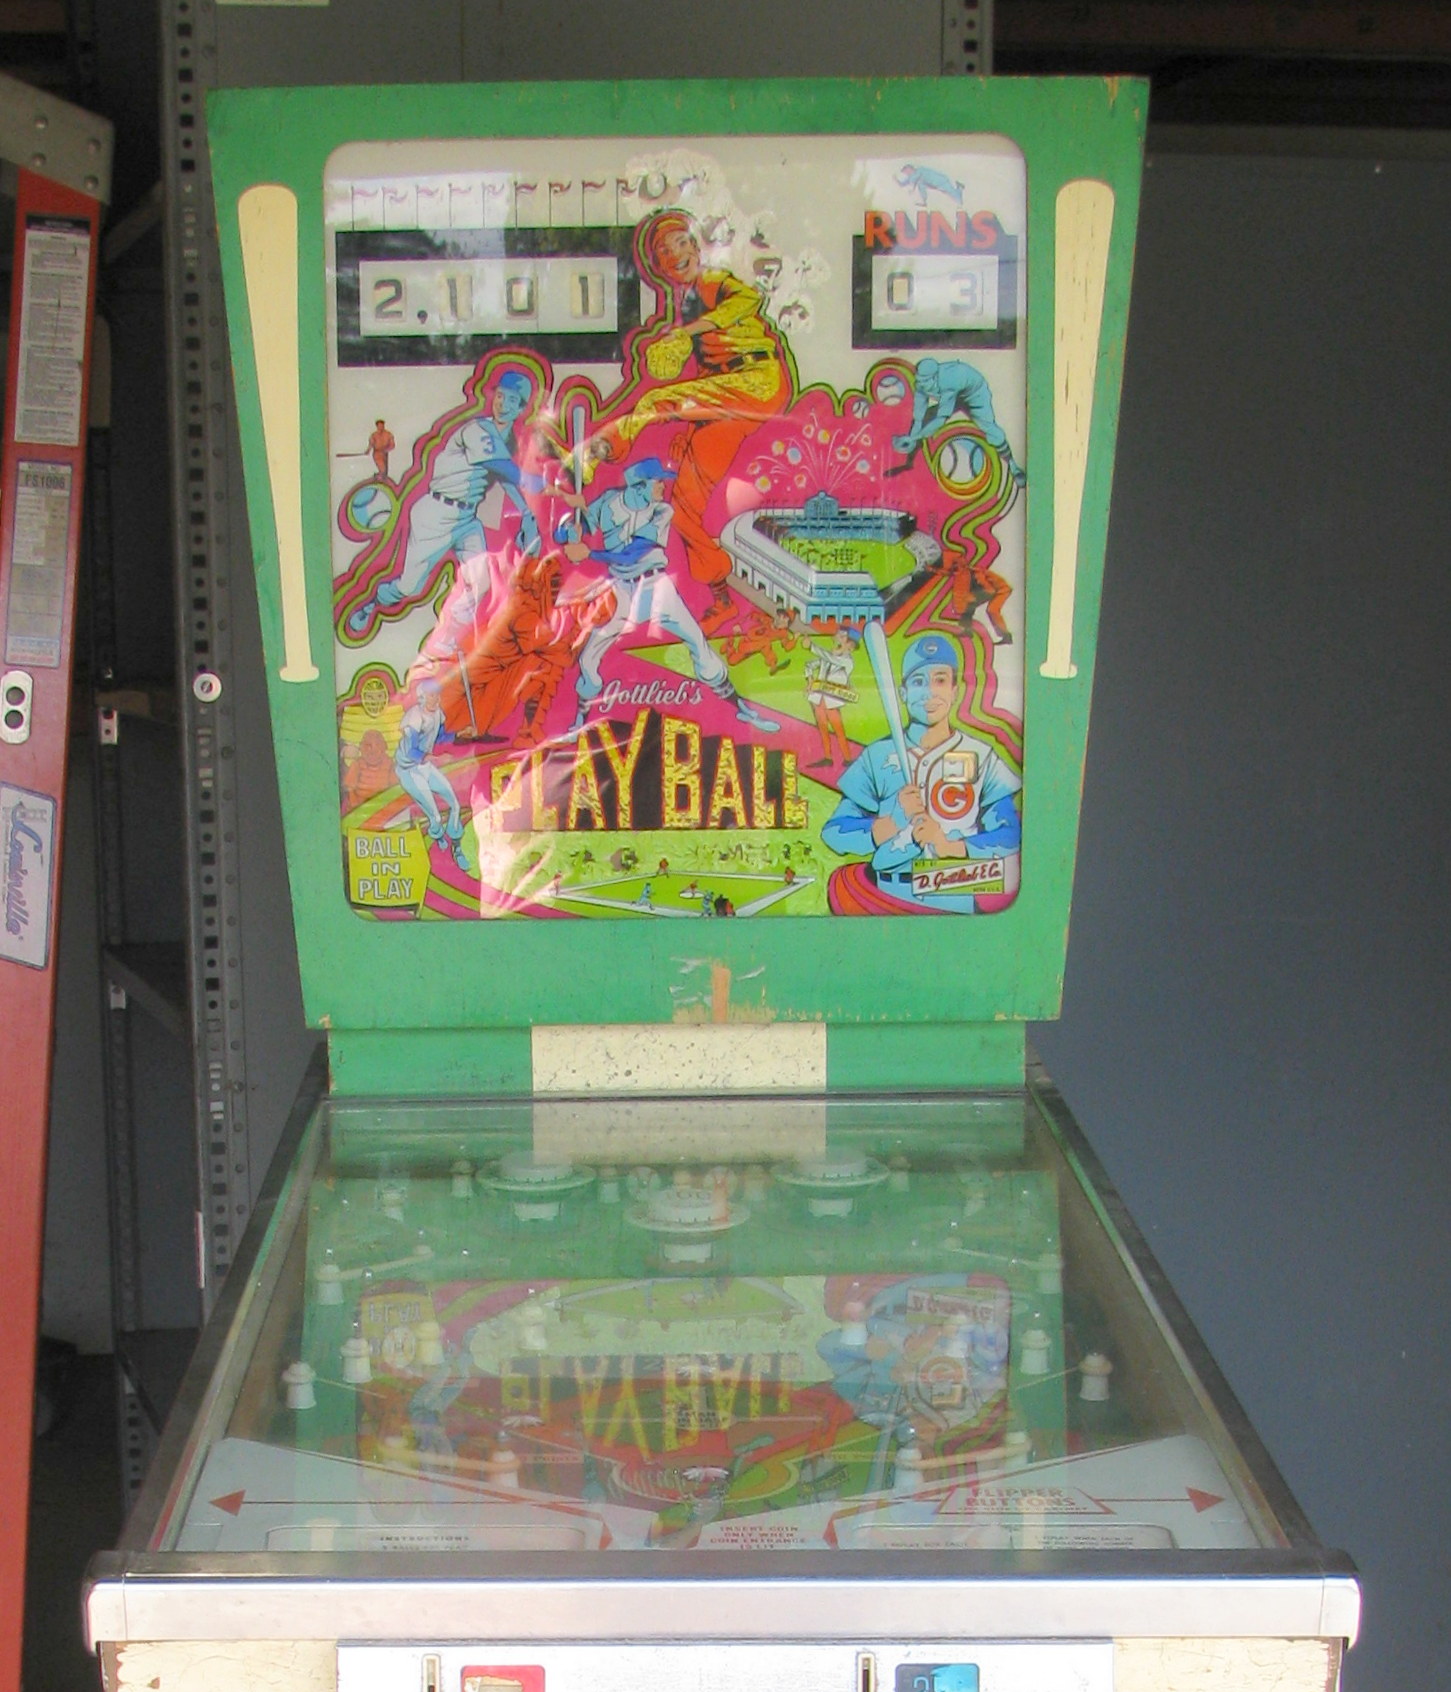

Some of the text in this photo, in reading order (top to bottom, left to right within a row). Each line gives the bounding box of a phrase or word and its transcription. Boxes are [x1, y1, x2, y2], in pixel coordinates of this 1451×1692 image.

[864, 210, 999, 249] RUNS
[598, 679, 704, 713] Gottlieb's
[490, 707, 809, 830] PLAY BALL
[937, 783, 968, 816] G
[355, 836, 411, 858] BALL
[371, 863, 402, 876] IN
[358, 878, 414, 900] PLAY
[965, 1496, 1077, 1507] BUTTONS
[971, 1486, 1065, 1497] FLIPPER
